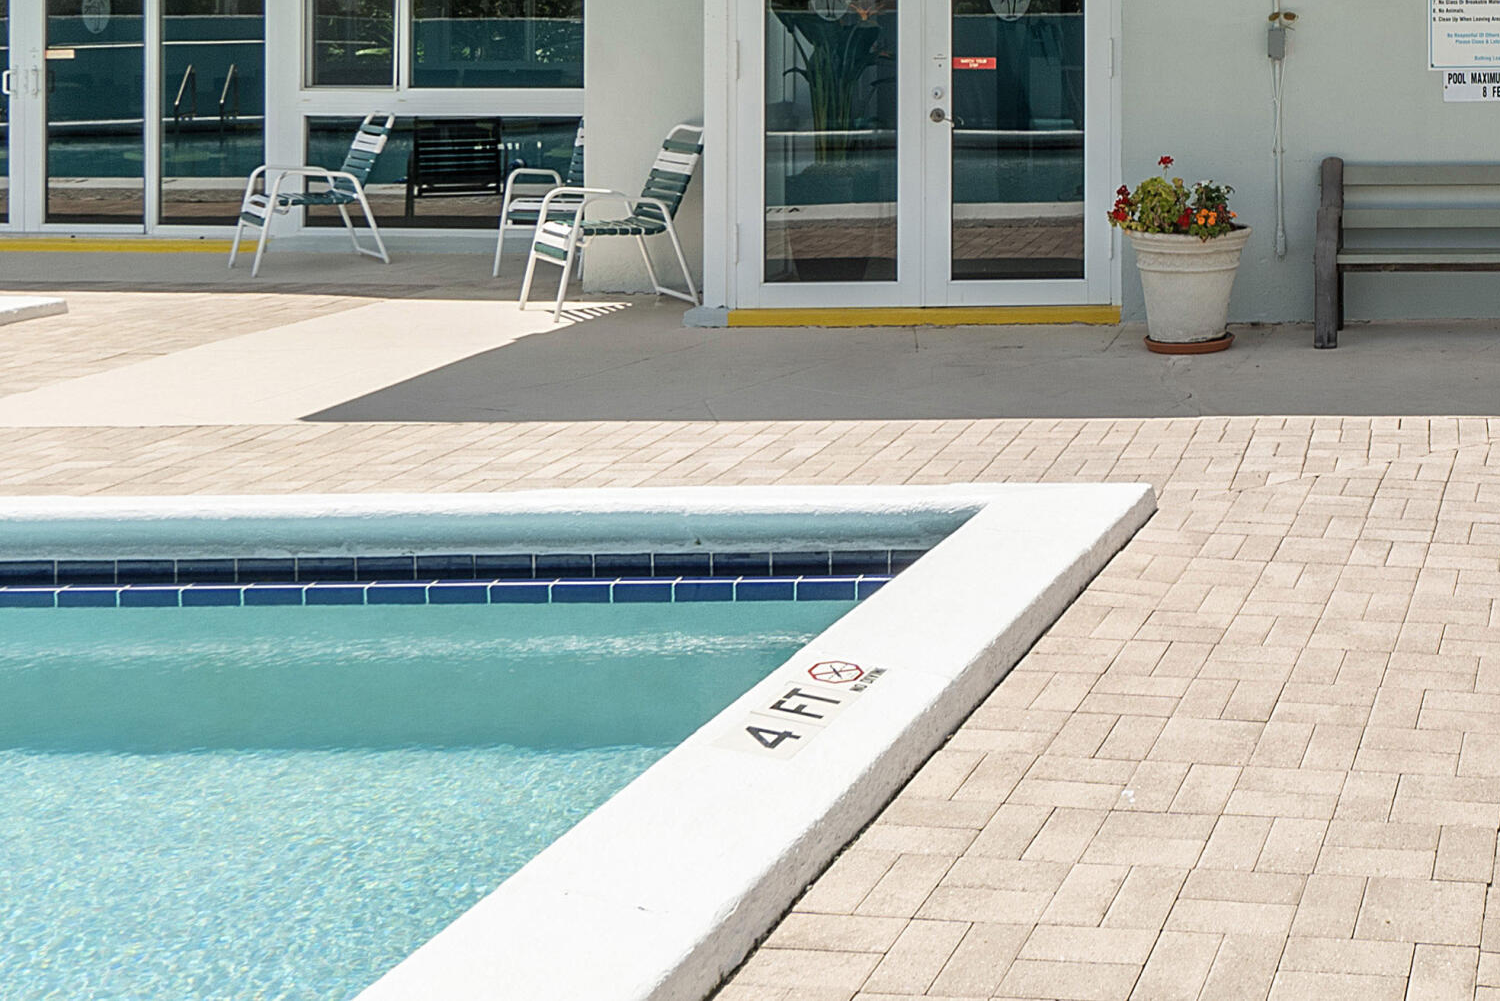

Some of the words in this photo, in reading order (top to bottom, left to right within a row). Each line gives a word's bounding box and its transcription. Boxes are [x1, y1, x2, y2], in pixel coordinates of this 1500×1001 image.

[1448, 73, 1466, 84] POOL
[1482, 86, 1487, 98] 8
[769, 688, 841, 719] FT
[746, 726, 802, 749] 4
